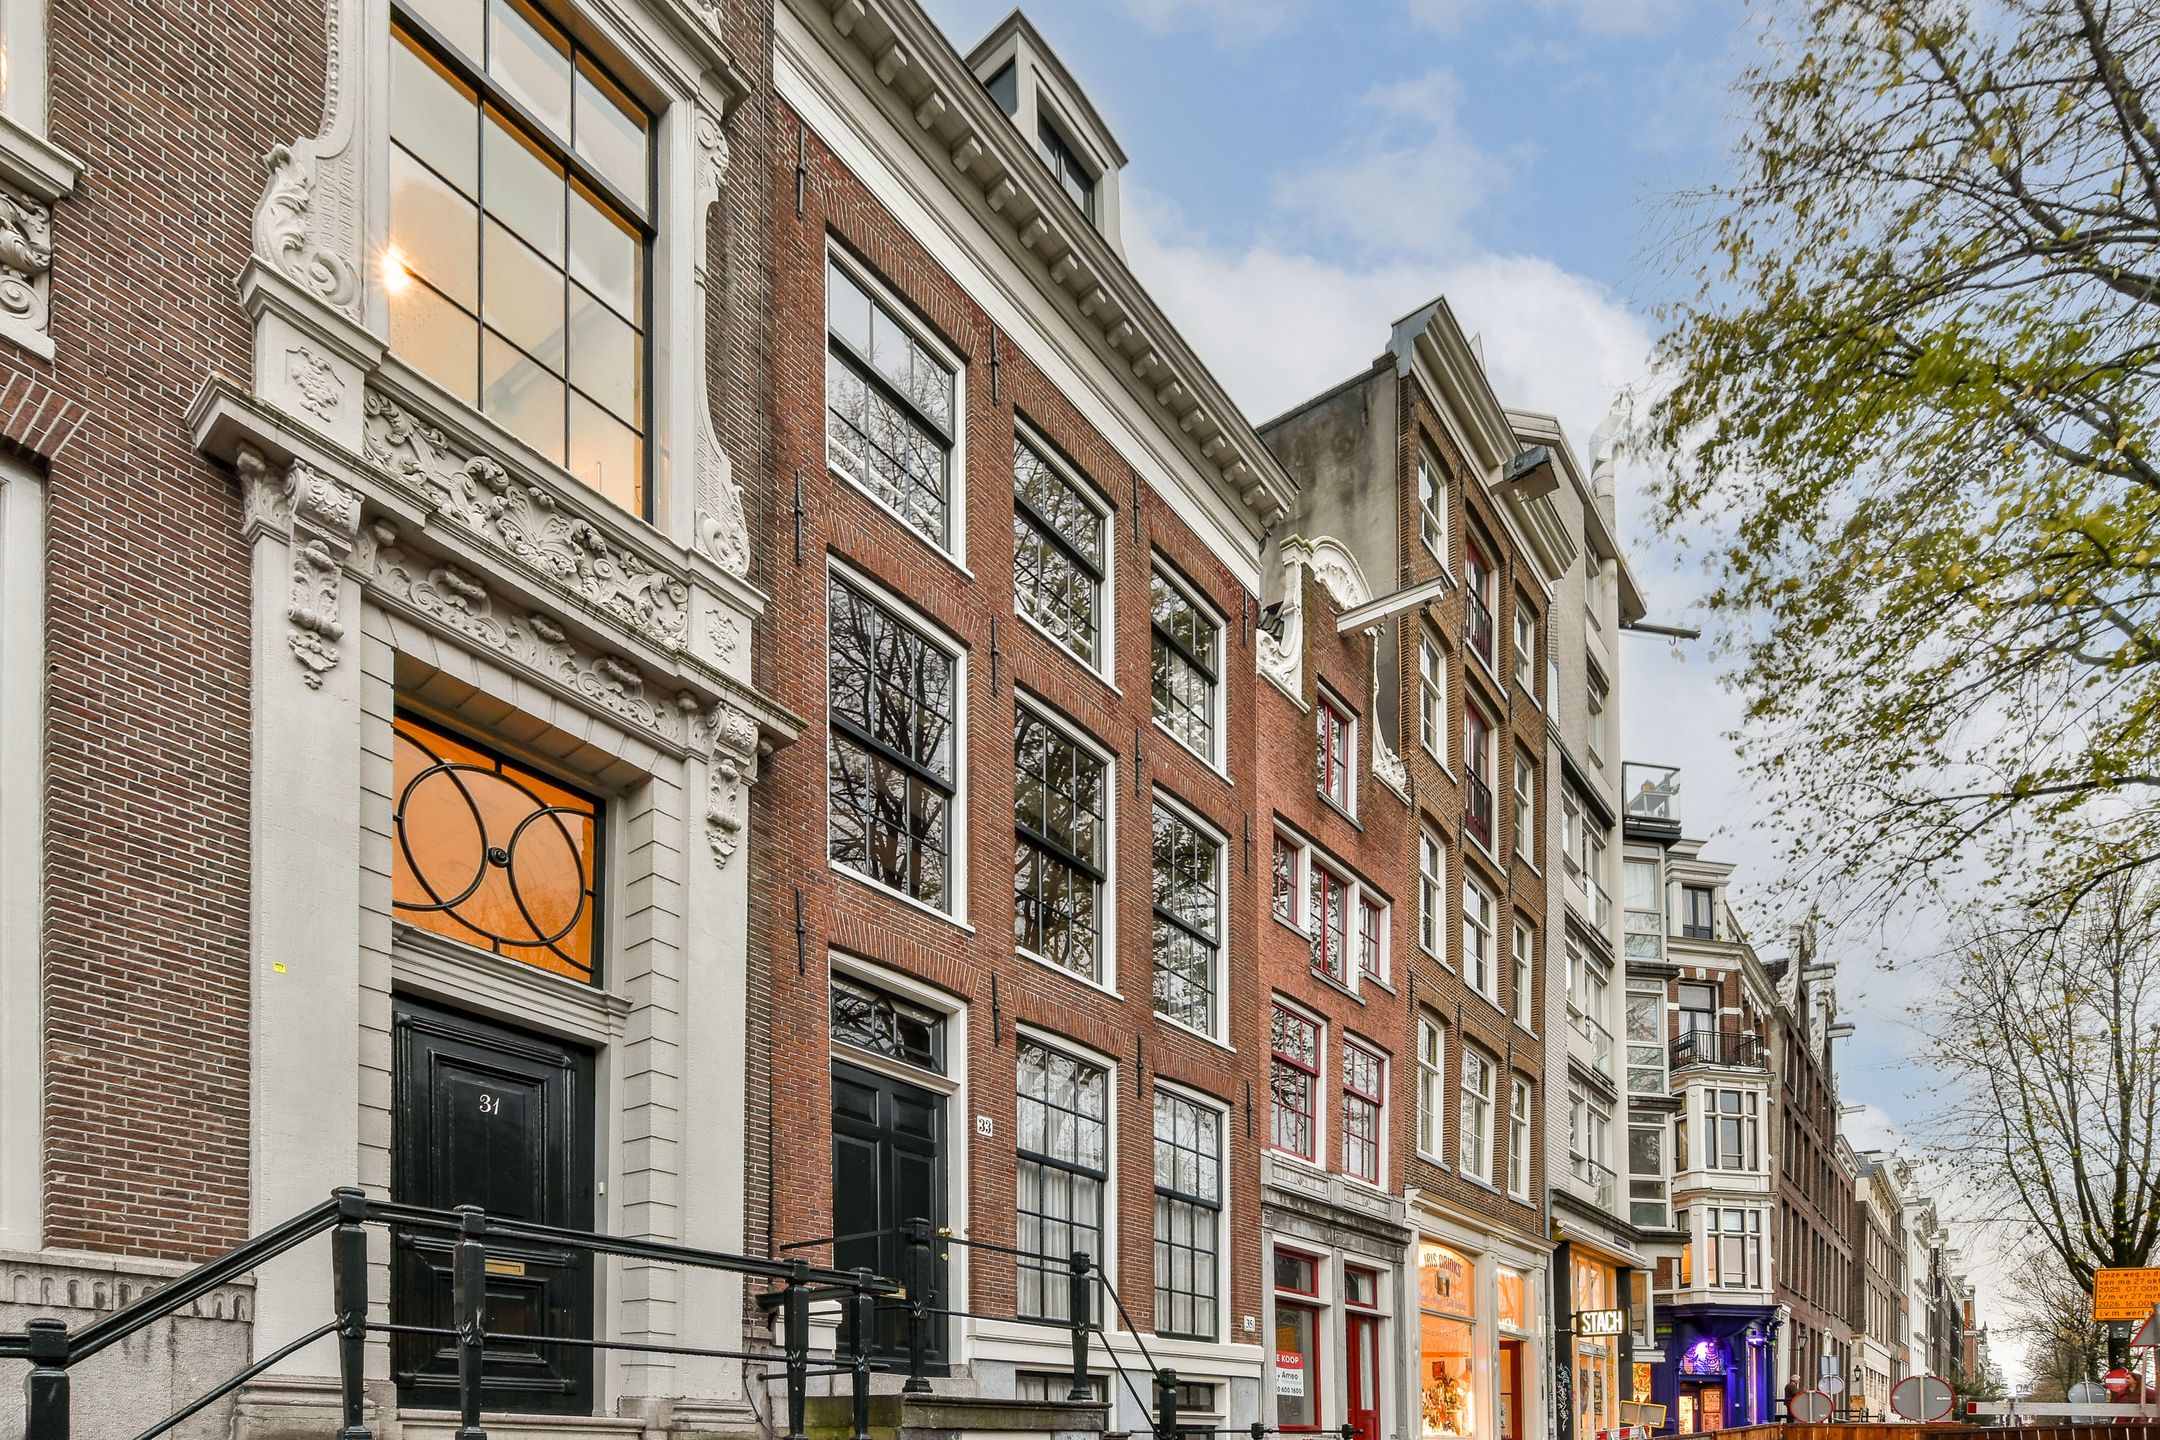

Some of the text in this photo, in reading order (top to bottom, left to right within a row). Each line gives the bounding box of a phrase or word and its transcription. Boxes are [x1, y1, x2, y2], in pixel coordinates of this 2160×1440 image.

[479, 1094, 500, 1115] 31
[979, 1118, 992, 1134] 33
[1423, 1253, 1462, 1278] IRIS DRINKS
[1581, 1310, 1623, 1333] STACH
[1281, 1354, 1300, 1365] KOOP
